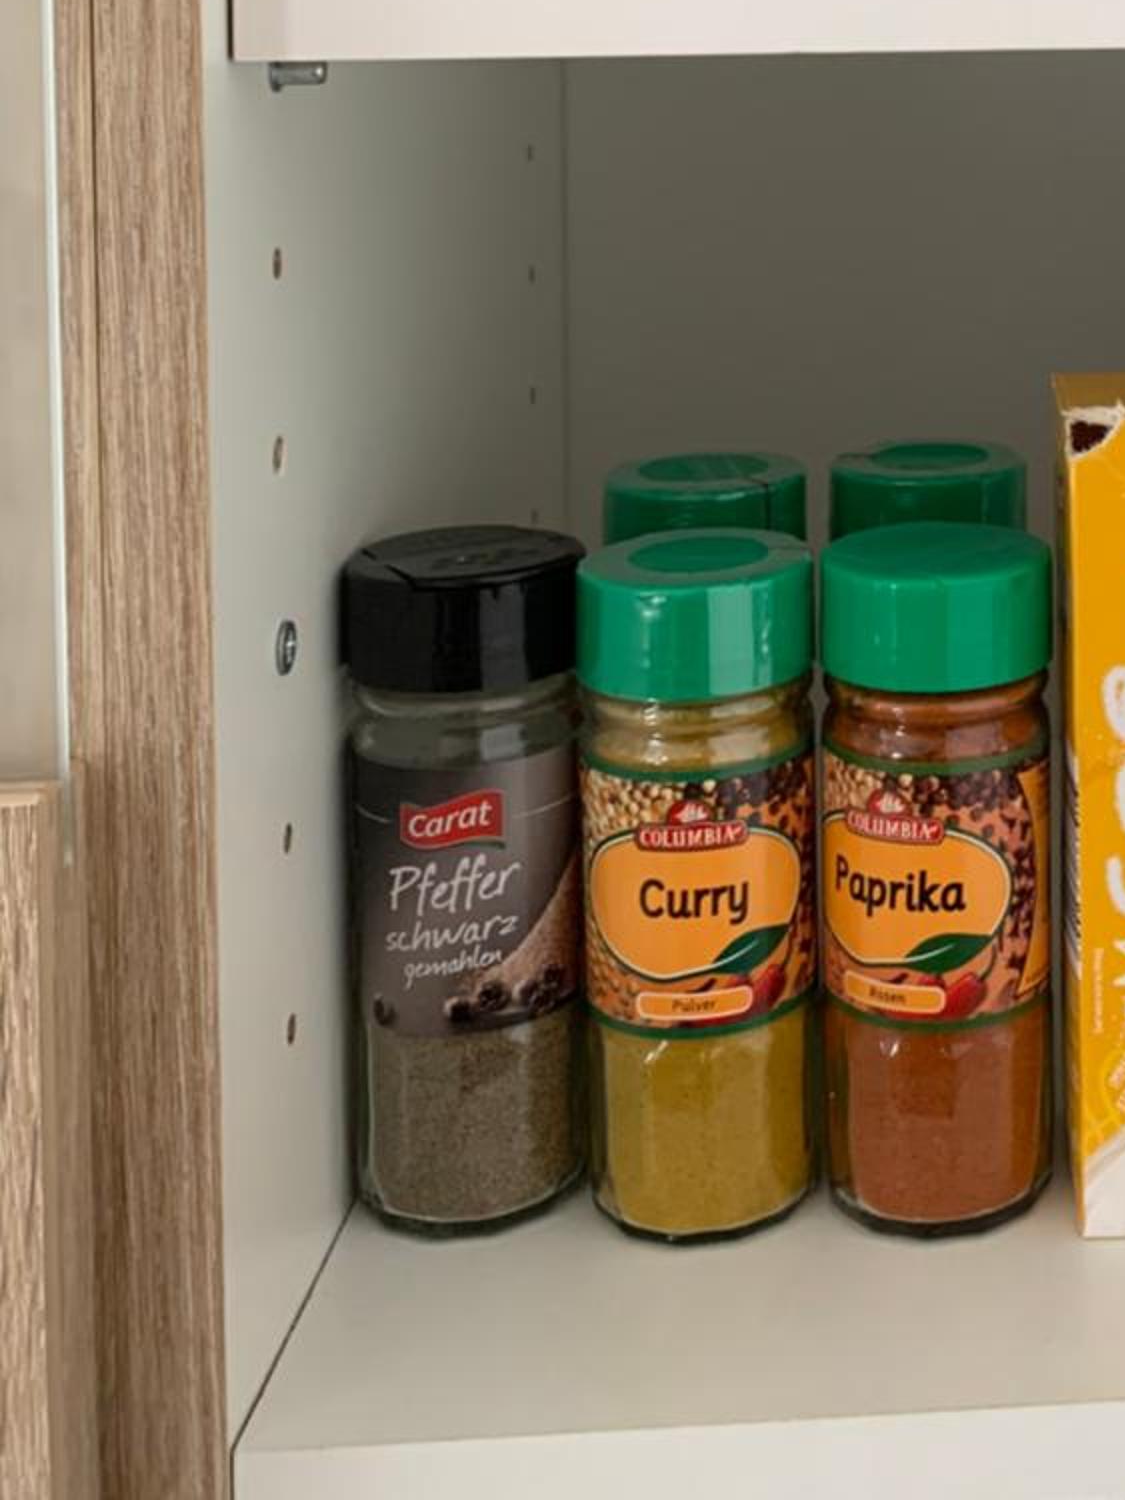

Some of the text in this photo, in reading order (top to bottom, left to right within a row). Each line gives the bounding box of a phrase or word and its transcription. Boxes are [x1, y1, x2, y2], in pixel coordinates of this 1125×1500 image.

[408, 799, 492, 838] Carat
[638, 824, 742, 848] COLUMBIA
[848, 812, 933, 840] COLUMBIA
[389, 853, 521, 917] Pfeffer
[638, 877, 749, 926] Curry
[835, 853, 967, 917] Paprika
[385, 915, 519, 951] schwarz
